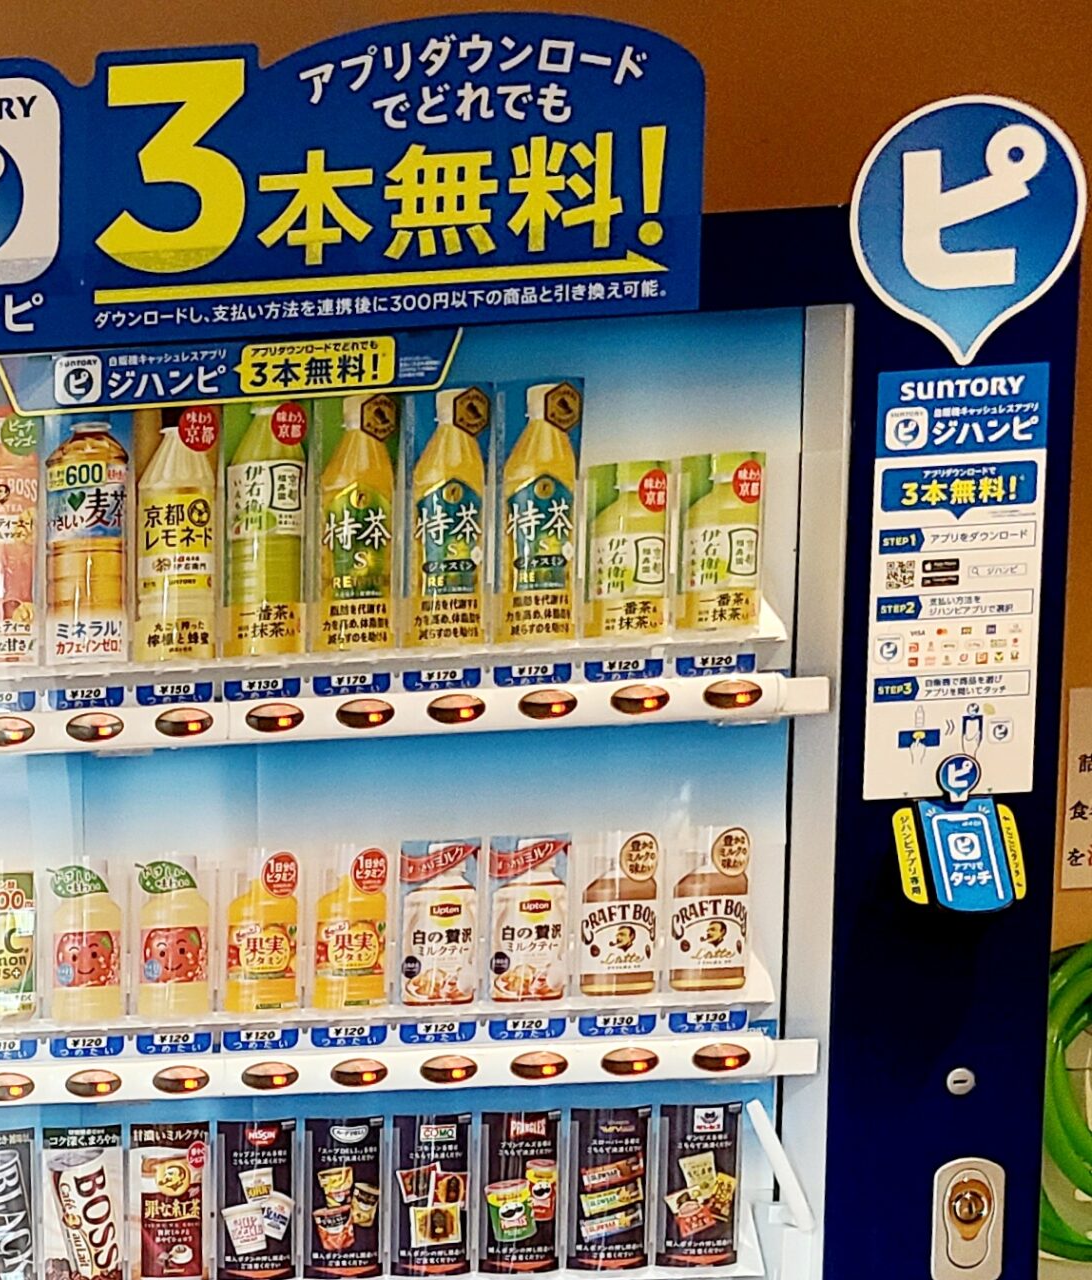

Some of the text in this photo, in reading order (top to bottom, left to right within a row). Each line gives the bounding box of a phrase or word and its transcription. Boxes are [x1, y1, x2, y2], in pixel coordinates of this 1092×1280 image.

[299, 35, 649, 104] アプリダウンロード
[373, 81, 572, 132] でどれでも
[95, 58, 668, 273] 3本無料!
[903, 123, 1046, 289] ピ
[251, 341, 378, 356] アプリダウンロードでどれでも
[109, 349, 227, 366] 自販機キャッシュレスアプリ
[250, 353, 380, 387] 3本無料!
[108, 366, 226, 398] ジハンピ
[900, 375, 1025, 401] SUNTORY
[185, 426, 215, 443] 京都
[277, 425, 302, 439] 京都
[932, 416, 1039, 445] ジハンピ
[66, 464, 103, 486] 600
[244, 465, 264, 530] 伊右衛門
[901, 475, 1017, 505] 3本無料!
[144, 504, 185, 528] 京都
[415, 502, 482, 545] 特茶
[507, 498, 573, 540] 特茶
[323, 507, 391, 550] 特茶
[931, 529, 1028, 543] アプリをダウンロード
[146, 528, 212, 550] レモネード
[354, 551, 367, 569] S
[608, 660, 639, 670] ¥120
[701, 655, 732, 665] ¥120
[425, 671, 457, 681] ¥170
[517, 665, 548, 675] ¥170
[247, 680, 278, 689] ¥130
[336, 675, 367, 685] ¥170
[70, 688, 101, 698] ¥120
[159, 684, 190, 694] ¥150
[947, 761, 973, 788] ピ
[950, 871, 992, 886] タッチ
[432, 905, 460, 916] Lipton
[522, 901, 549, 912] Lipton
[581, 904, 631, 945] CRAFT
[671, 899, 722, 940] CRAFT
[245, 935, 284, 954] 果実
[334, 932, 373, 951] 果実
[507, 942, 558, 952] ミルクティー
[419, 946, 469, 957] ミルクティー
[512, 1019, 542, 1029] ¥120
[602, 1016, 633, 1026] ¥130
[695, 1012, 726, 1022] ¥130
[334, 1026, 365, 1036] ¥120
[424, 1023, 455, 1033] ¥120
[499, 1029, 556, 1039] つめたい
[679, 1022, 737, 1032] つめたい
[71, 1037, 103, 1047] ¥120
[159, 1034, 190, 1043] ¥120
[245, 1030, 276, 1040] ¥120
[322, 1036, 376, 1046] つめたい
[147, 1043, 201, 1053] つめたい
[74, 1165, 119, 1270] BOSS
